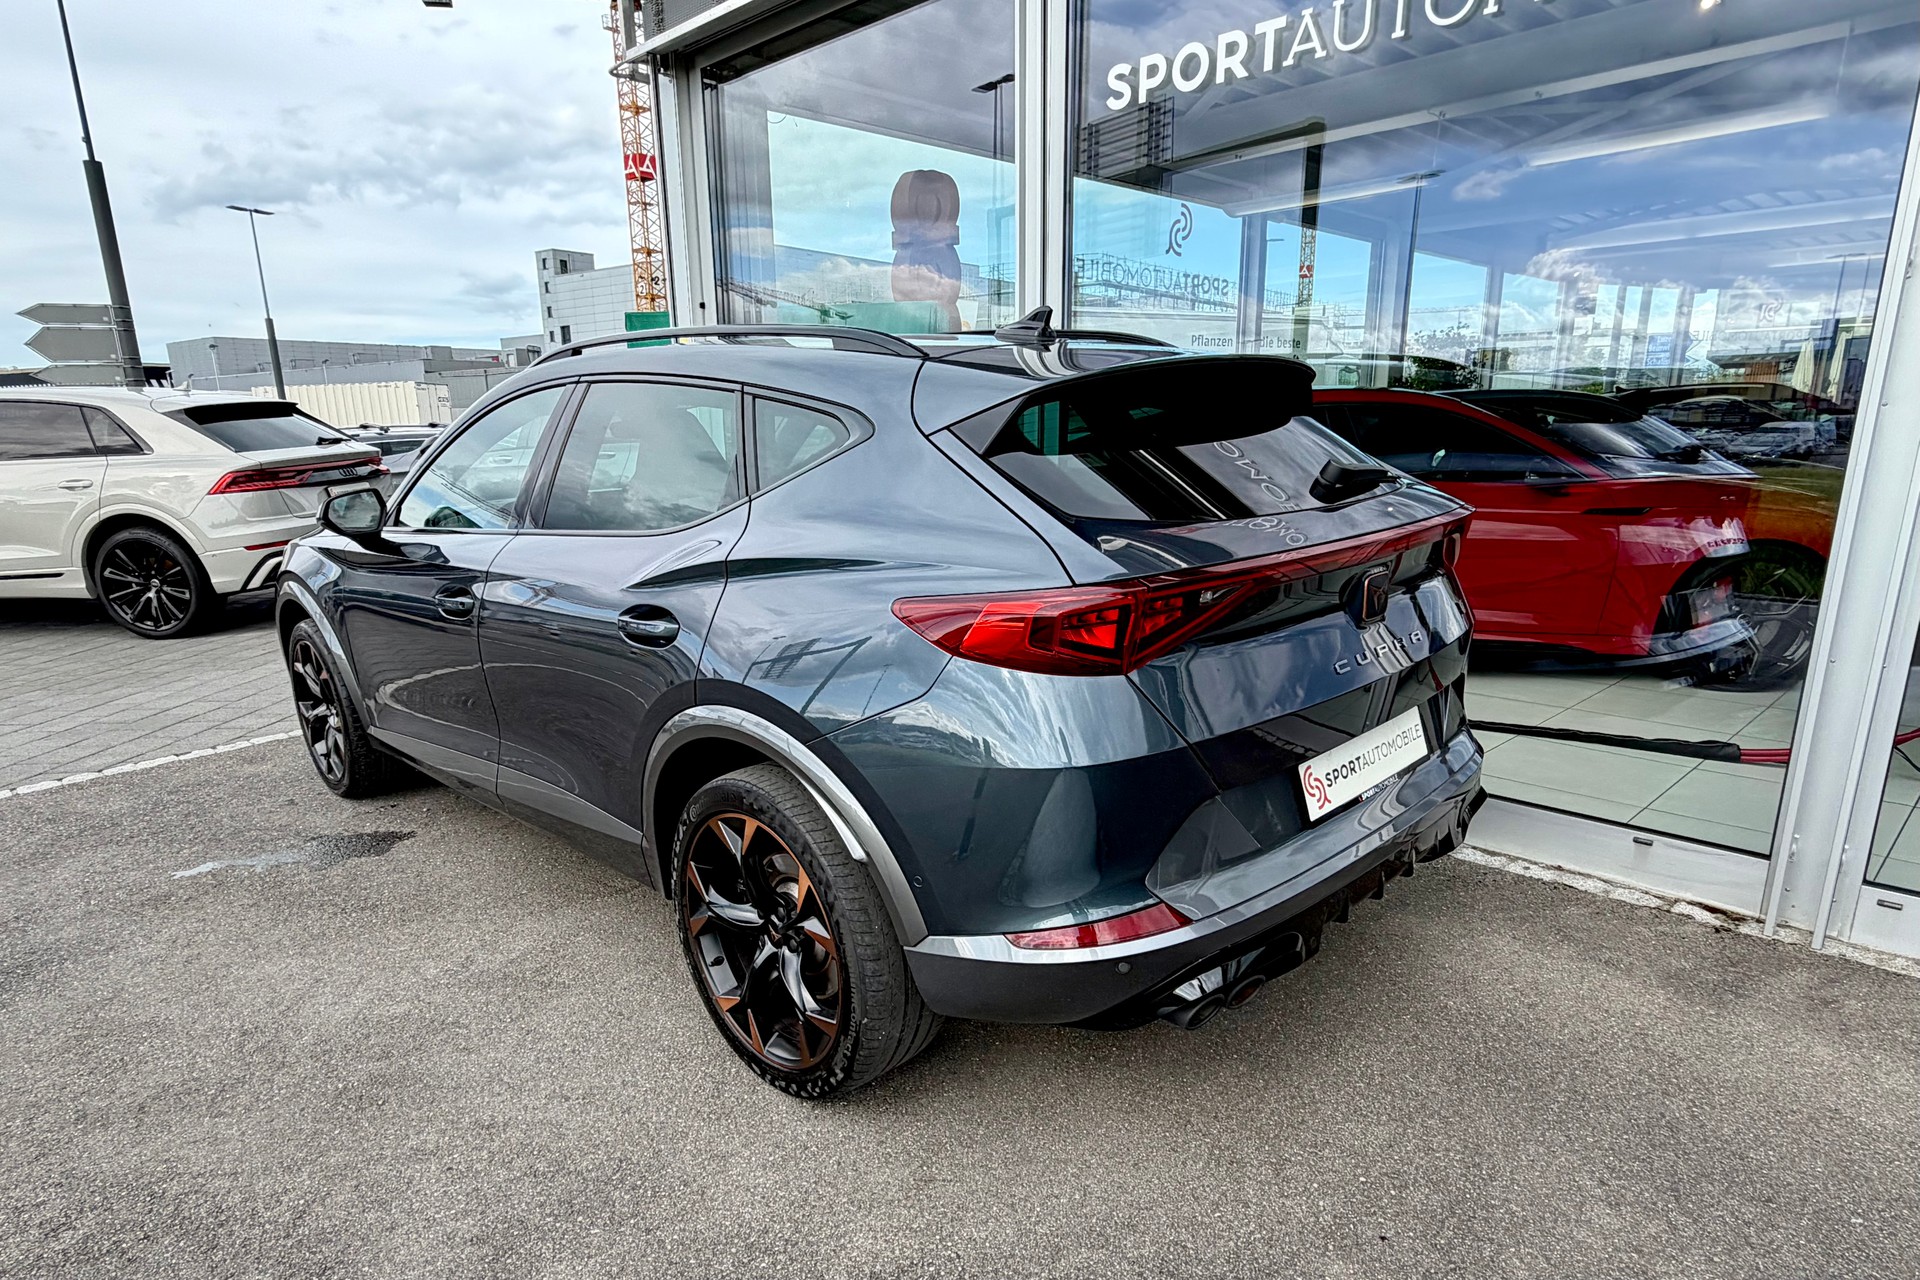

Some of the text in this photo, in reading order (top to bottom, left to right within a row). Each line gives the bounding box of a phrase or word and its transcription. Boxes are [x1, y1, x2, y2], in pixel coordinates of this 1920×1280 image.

[1191, 334, 1233, 347] Pflanzen
[1277, 336, 1301, 349] beste
[1333, 630, 1423, 675] CUPRA
[1325, 724, 1422, 788] SPORTAUTOMOBILE
